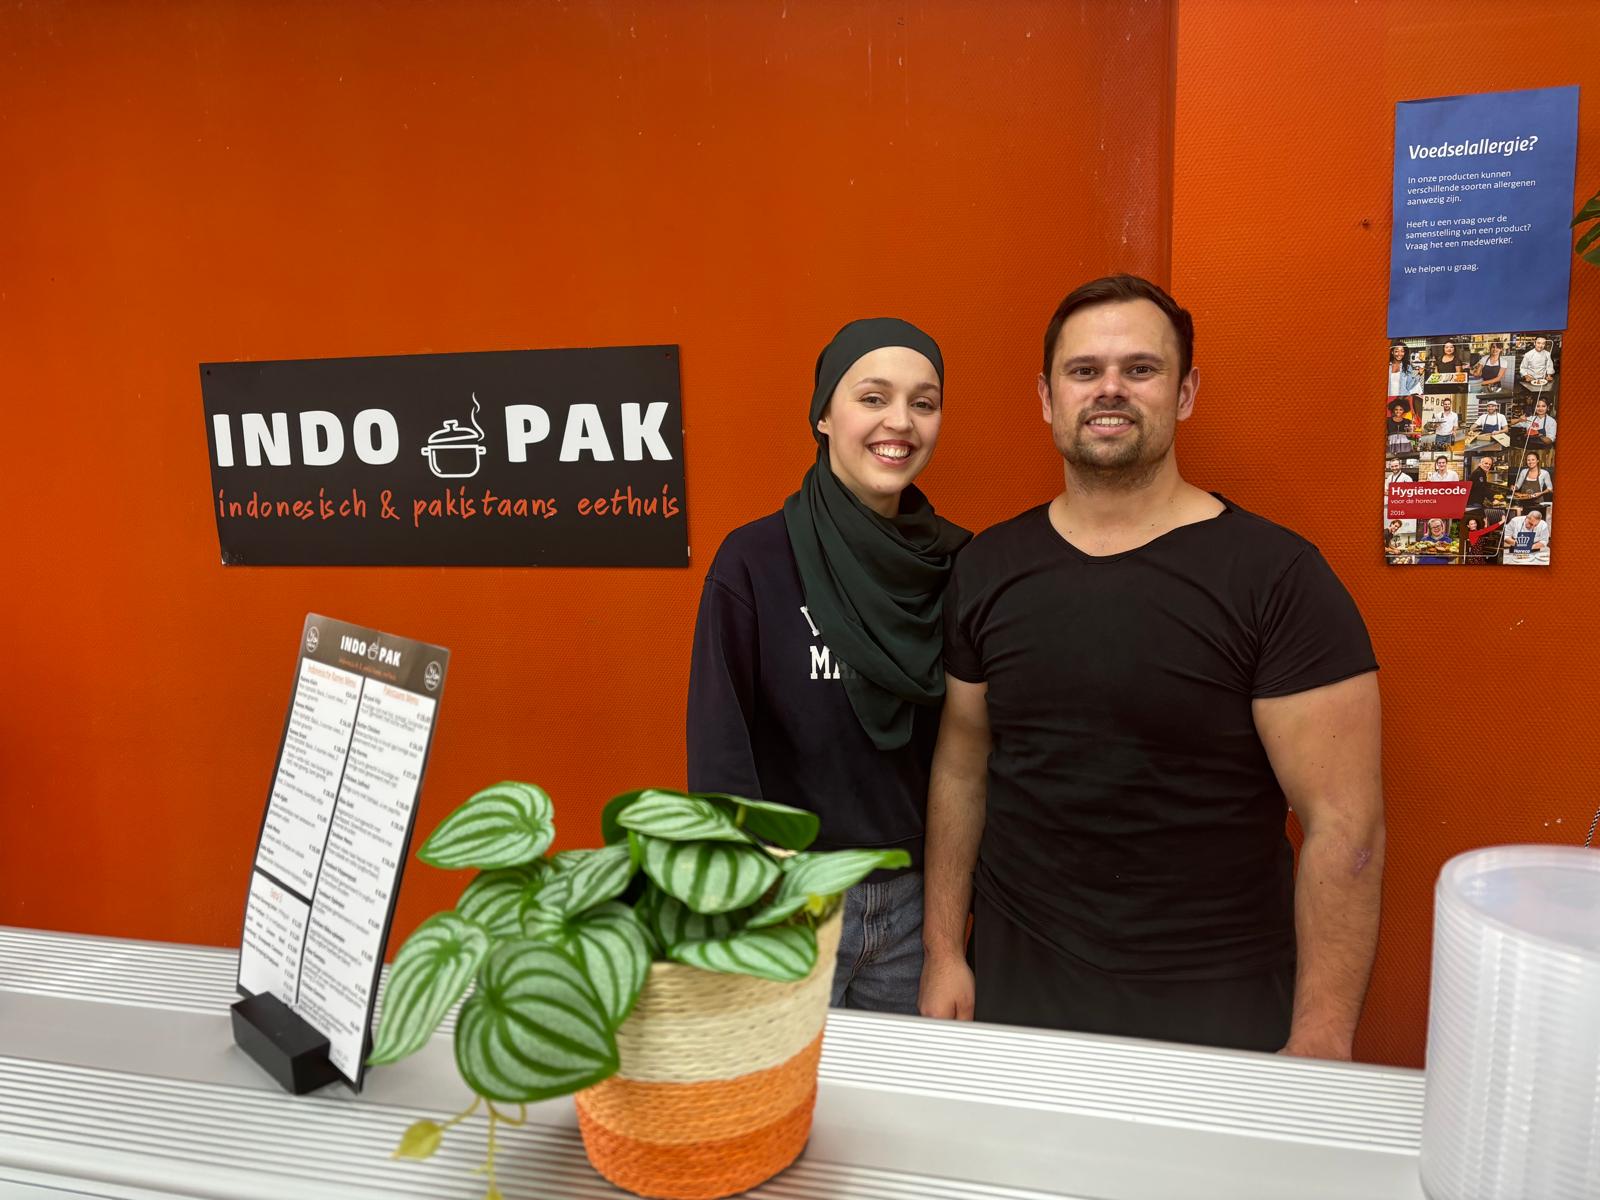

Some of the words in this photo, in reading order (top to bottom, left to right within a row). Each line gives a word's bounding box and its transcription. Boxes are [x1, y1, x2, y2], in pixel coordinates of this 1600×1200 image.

[1409, 136, 1538, 160] Voedselallergie?
[1408, 176, 1416, 184] In
[1438, 173, 1479, 184] producten
[1481, 170, 1511, 179] kunnen
[1407, 184, 1459, 195] verschillende
[1460, 182, 1492, 191] soorten
[1493, 180, 1536, 190] allergenen
[1407, 196, 1445, 206] aanwezig
[1446, 195, 1462, 205] zijn.
[1406, 219, 1428, 229] Heeft
[1453, 217, 1476, 227] vraag
[1477, 216, 1495, 224] over
[1496, 214, 1508, 223] de
[1405, 228, 1461, 239] samenstelling
[1495, 223, 1532, 236] product?
[1405, 242, 1428, 252] Vraag
[1430, 240, 1444, 249] het
[1444, 240, 1459, 248] een
[1461, 237, 1513, 247] medewerker.
[1404, 265, 1417, 274] We
[1418, 264, 1446, 274] helpen
[1447, 264, 1453, 272] u
[1454, 262, 1479, 273] graag.
[212, 408, 400, 467] INDO
[504, 401, 673, 463] PAK
[1391, 486, 1467, 498] Hygiënecode
[219, 488, 367, 520] indonesisch
[380, 489, 400, 519] &
[413, 485, 558, 527] pakistaans
[577, 483, 680, 518] eethuis
[340, 635, 367, 656] INDO
[378, 646, 402, 667] PAK
